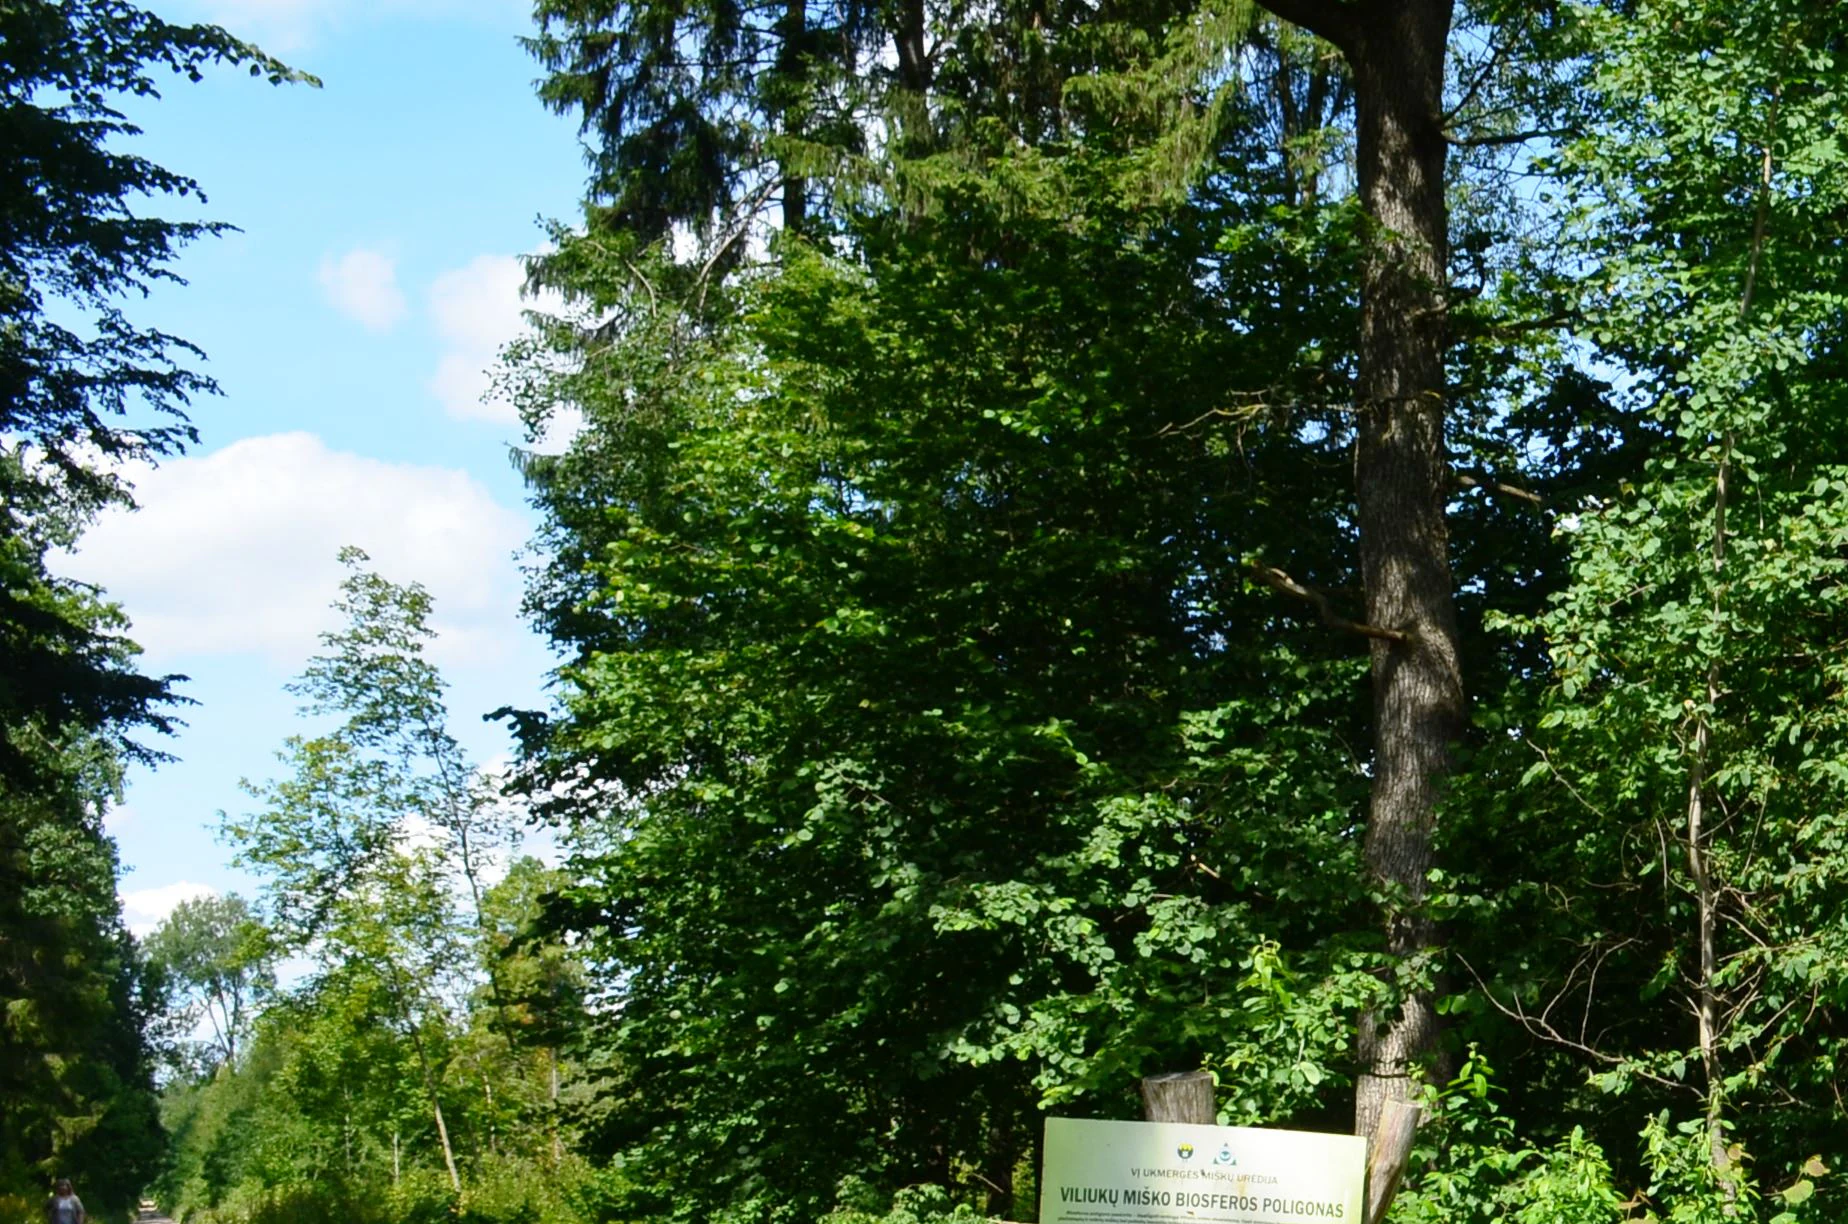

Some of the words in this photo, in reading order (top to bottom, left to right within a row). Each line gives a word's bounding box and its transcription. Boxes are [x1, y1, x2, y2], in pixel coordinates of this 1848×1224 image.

[1061, 1186, 1119, 1208] VILIUKŲ
[1123, 1186, 1171, 1206] MIŠKO
[1176, 1192, 1258, 1212] BIOSFEROS
[1262, 1197, 1344, 1218] POLIGONAS
